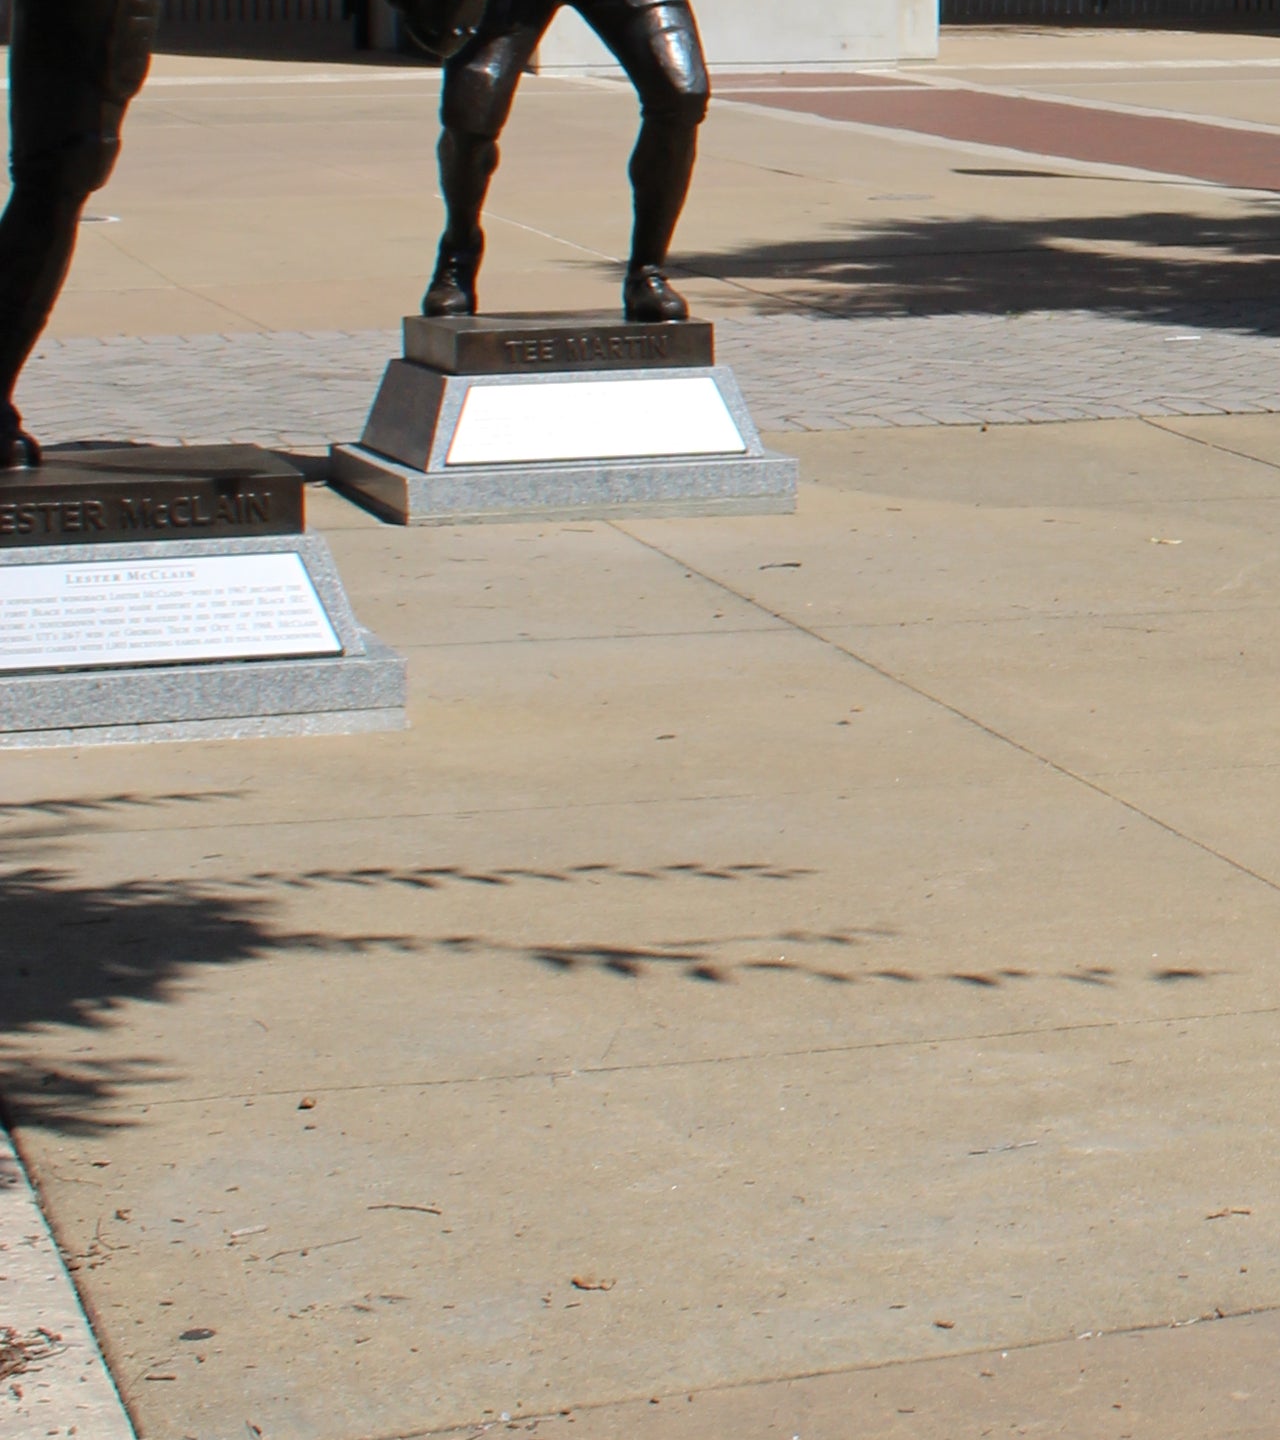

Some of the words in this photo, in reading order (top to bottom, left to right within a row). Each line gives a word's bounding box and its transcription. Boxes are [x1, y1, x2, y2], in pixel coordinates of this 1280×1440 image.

[504, 337, 555, 364] TEE
[565, 334, 669, 362] MARTIN
[120, 492, 272, 530] McCLAIN
[65, 573, 122, 585] LESTER
